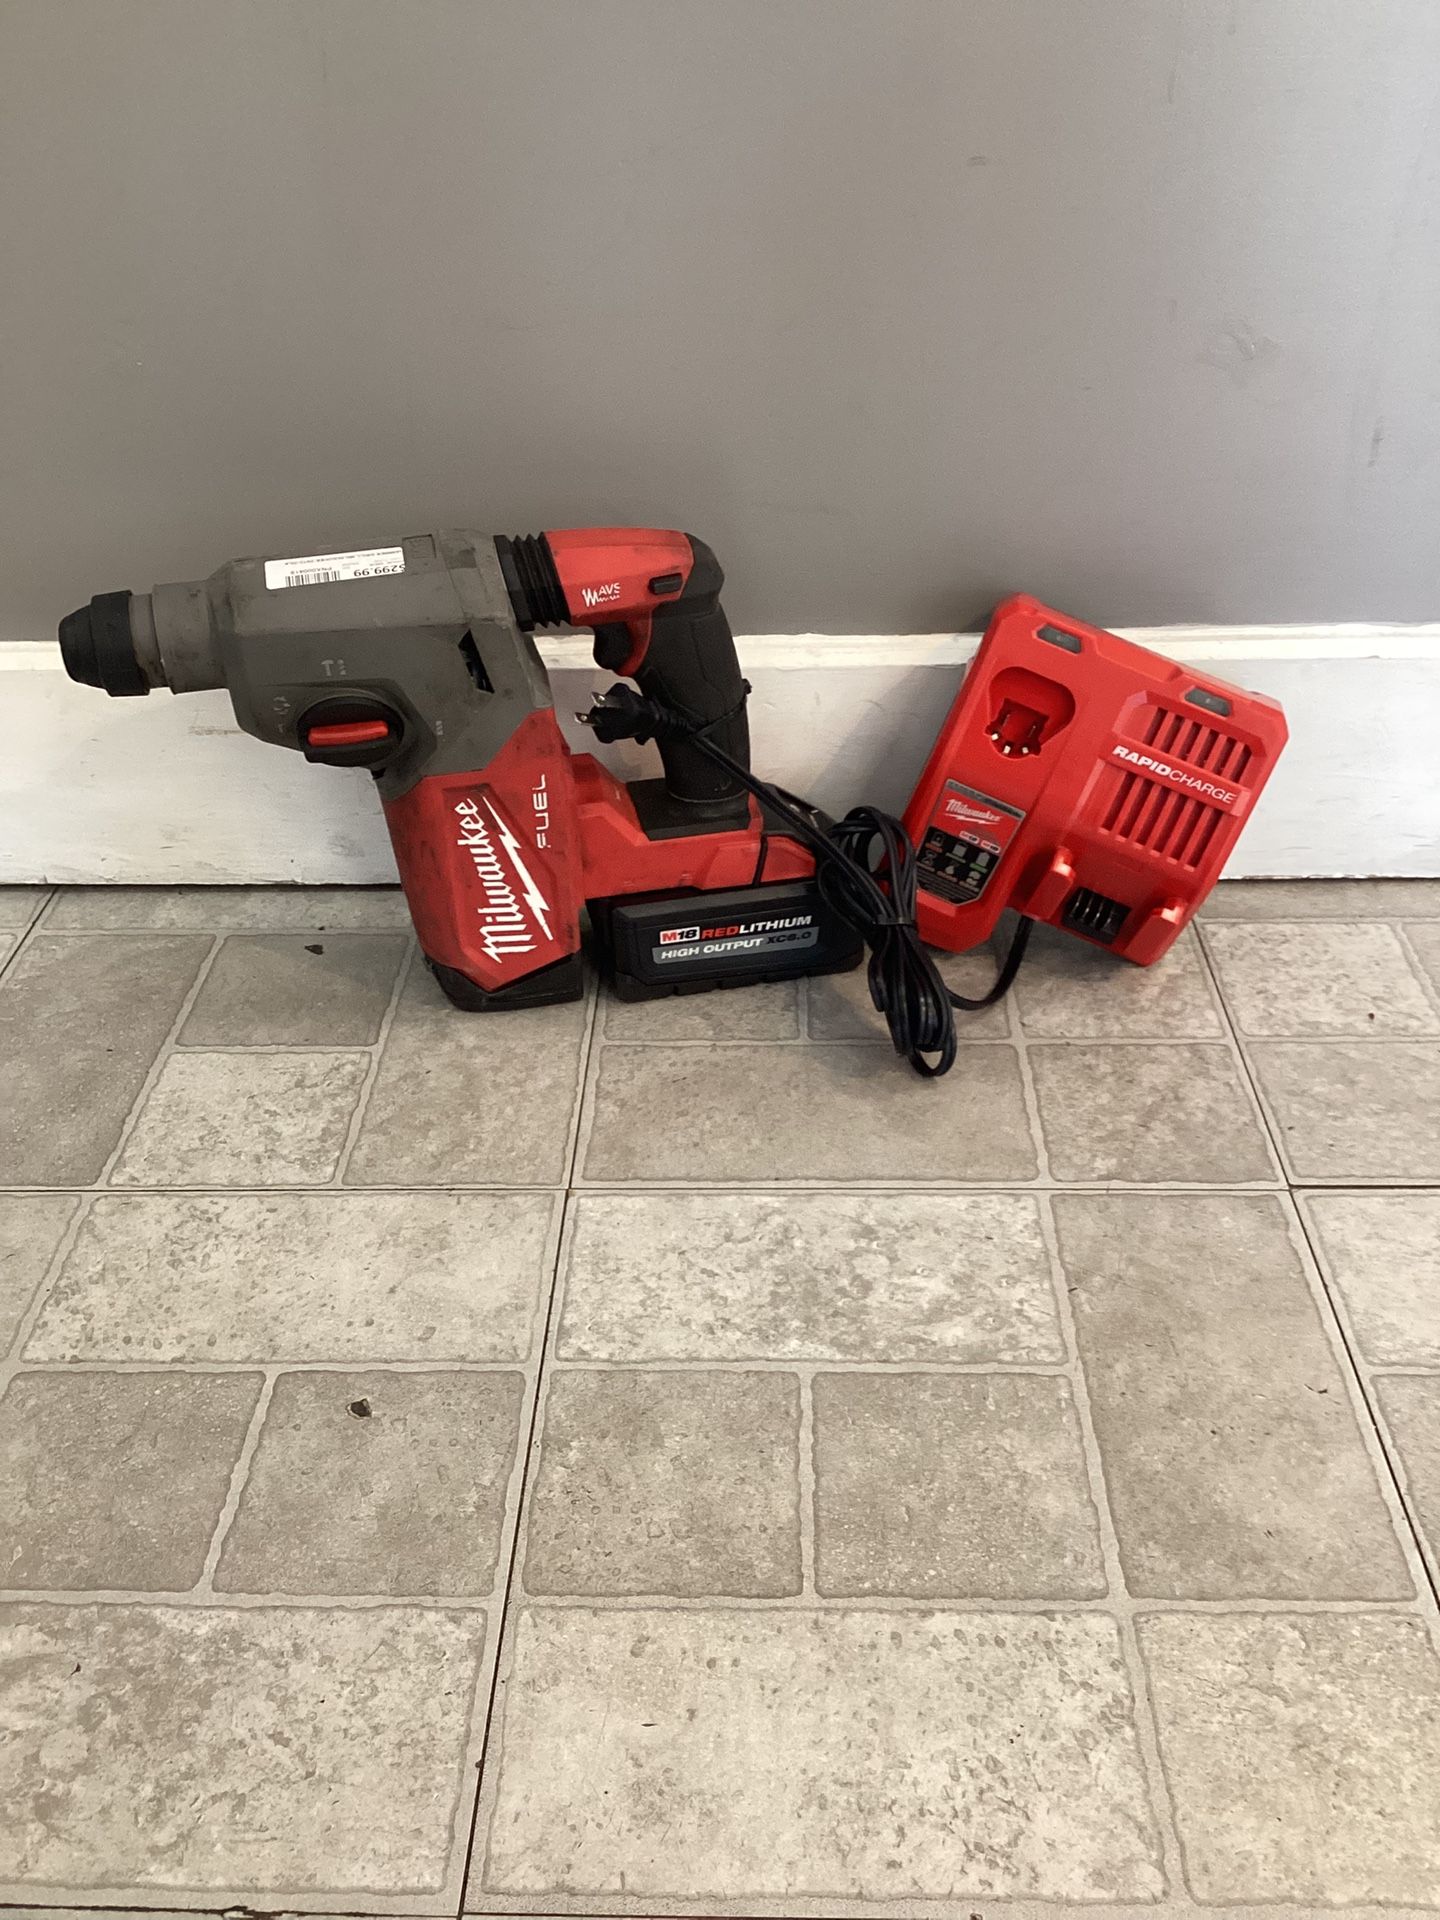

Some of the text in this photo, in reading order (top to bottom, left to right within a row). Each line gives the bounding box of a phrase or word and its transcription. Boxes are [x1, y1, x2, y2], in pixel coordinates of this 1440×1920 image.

[1111, 744, 1238, 805] RAPIDCHARGE
[531, 773, 553, 850] FUEL
[454, 797, 540, 965] Milwaukee
[660, 946, 700, 960] HIGH
[702, 937, 764, 954] OUTPUT
[661, 914, 813, 943] M18 REDLITHIUM
